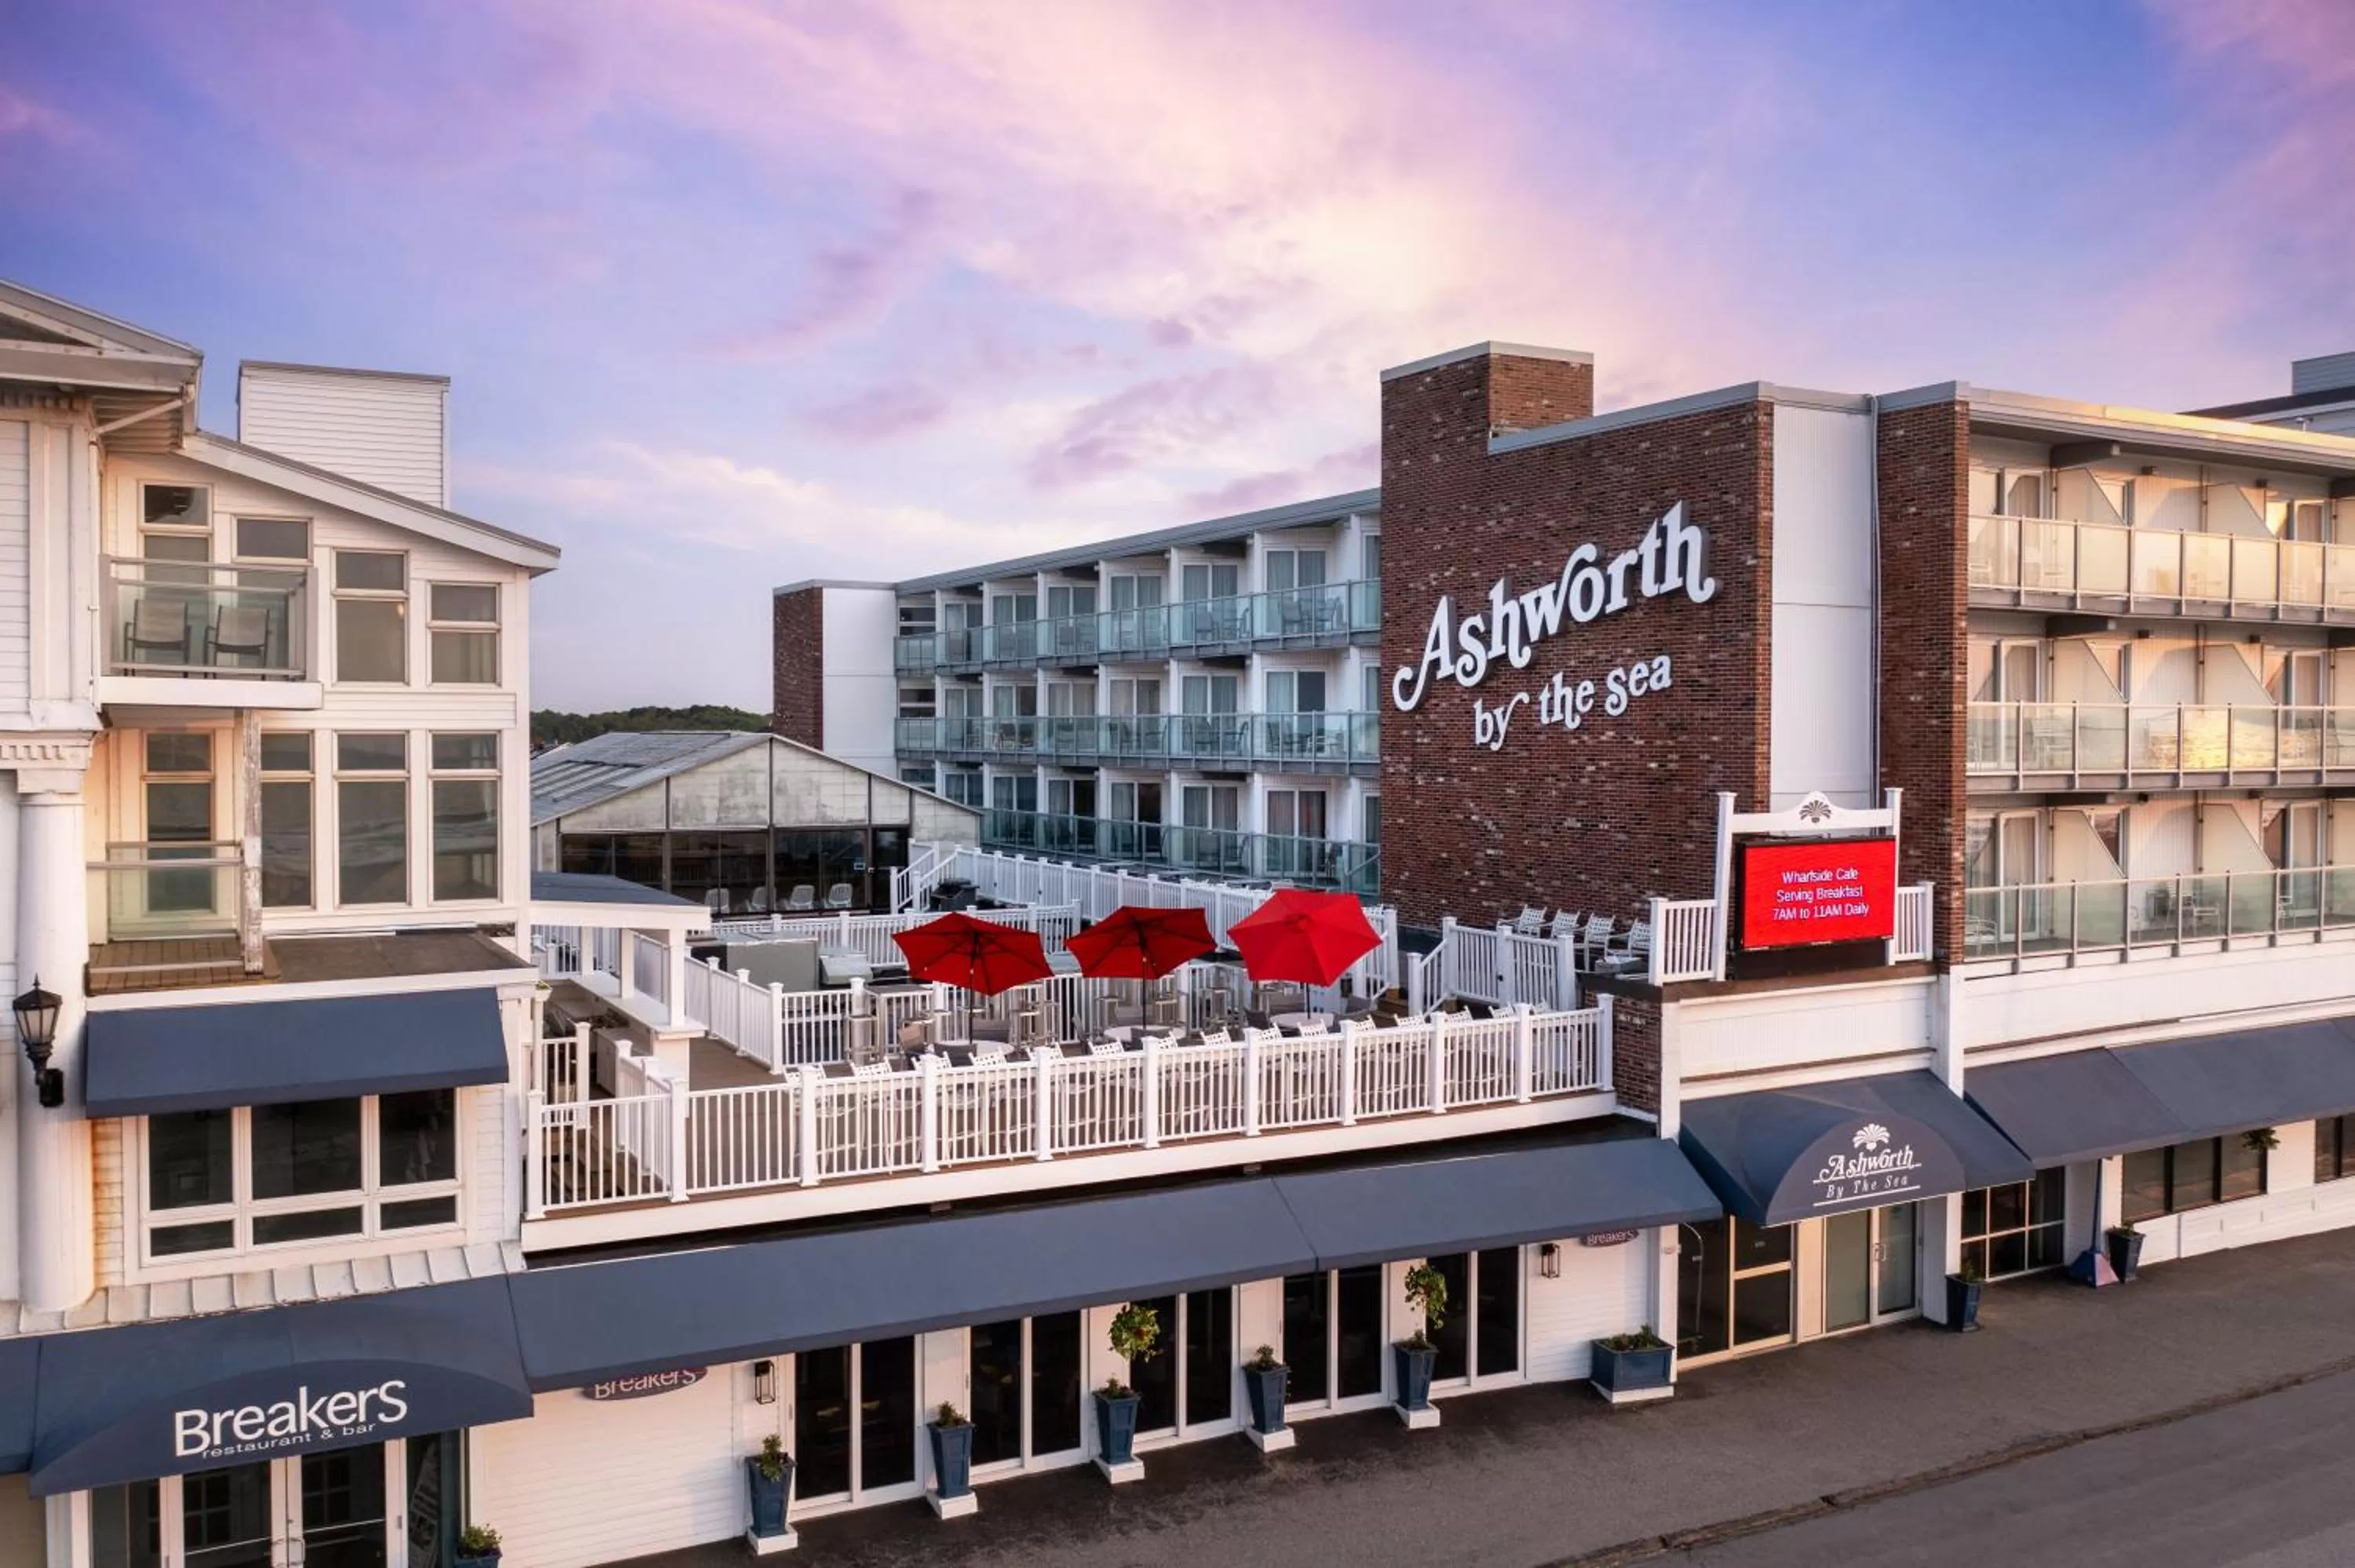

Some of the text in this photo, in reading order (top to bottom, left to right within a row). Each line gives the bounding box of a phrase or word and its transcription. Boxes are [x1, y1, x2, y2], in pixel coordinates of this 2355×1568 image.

[1393, 500, 1716, 711] Ashworth
[1475, 655, 1672, 751] by the sea
[1782, 866, 1858, 884] Wharfside Cafe
[1776, 884, 1863, 903] Serving Breakfast
[1773, 901, 1869, 921] 7AM to 11AM Daily
[1819, 1145, 1915, 1182] Ashworth
[1827, 1174, 1908, 1199] By The Sea
[202, 1422, 376, 1458] restaurant & bar
